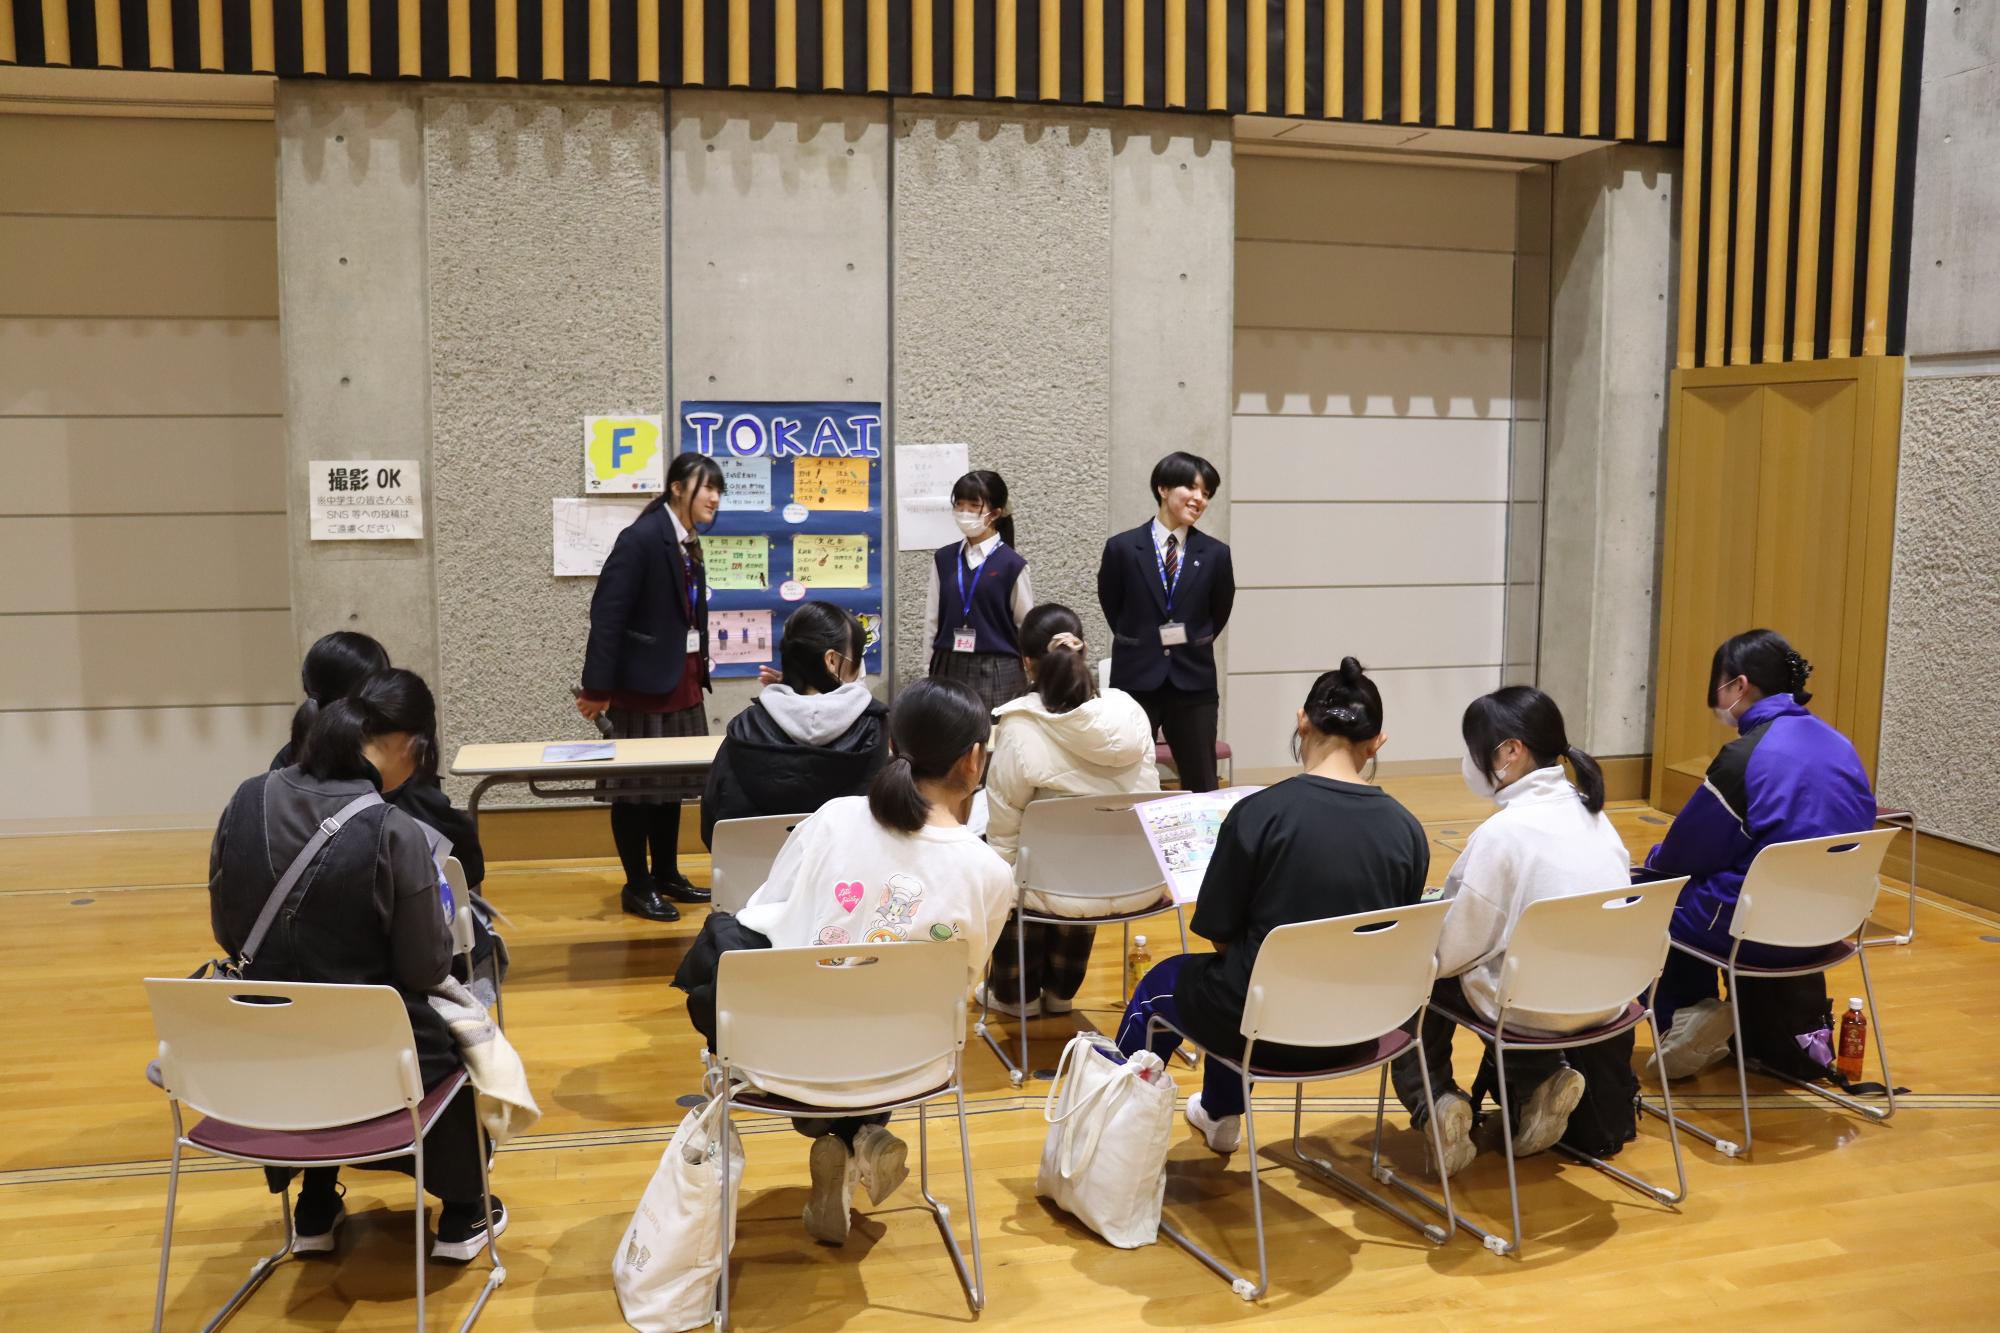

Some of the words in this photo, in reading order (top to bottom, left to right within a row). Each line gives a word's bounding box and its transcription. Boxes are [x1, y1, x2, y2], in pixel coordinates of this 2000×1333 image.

[685, 412, 881, 458] TOKAI
[612, 428, 636, 468] F
[328, 468, 369, 491] 撮影
[376, 468, 402, 489] OK
[327, 510, 349, 519] SNS
[352, 509, 409, 519] 等への投稿は
[327, 524, 396, 534] ご遠慮ください
